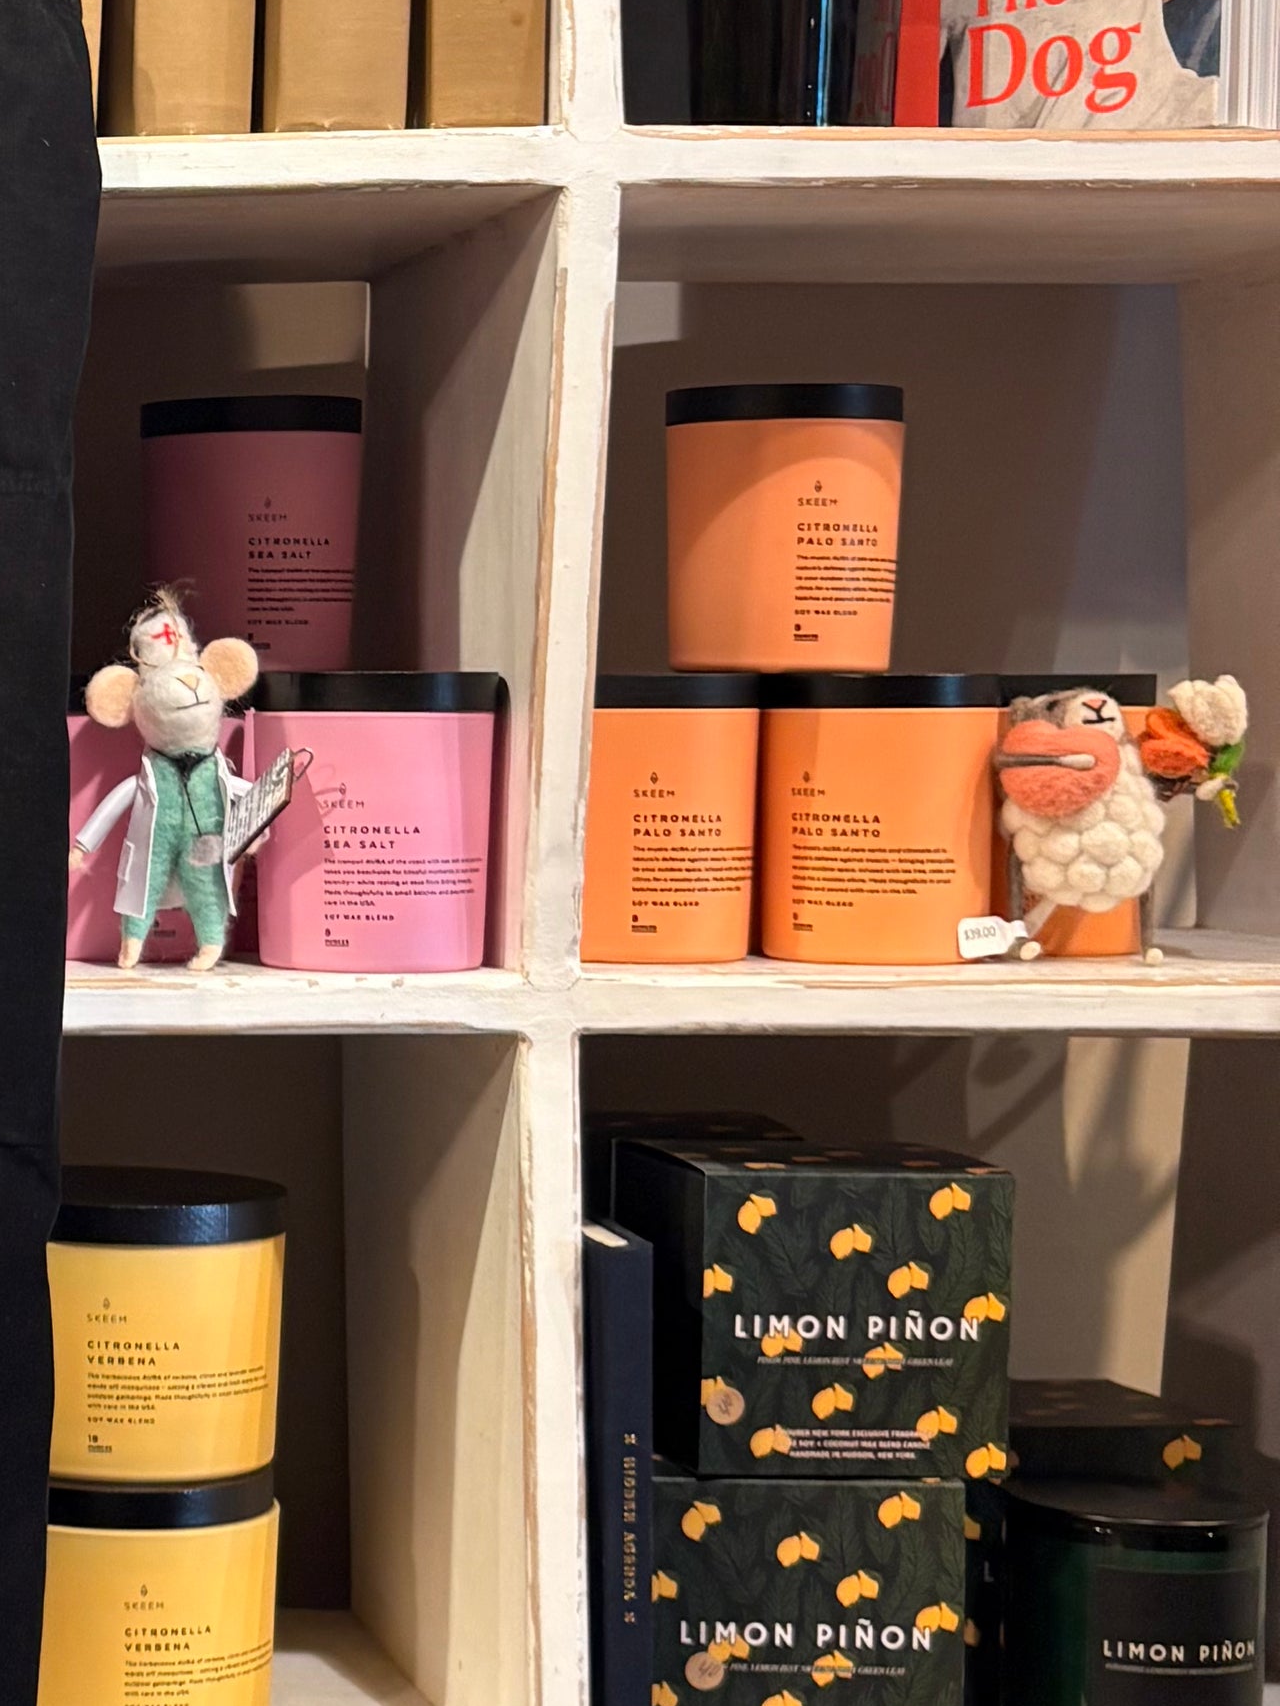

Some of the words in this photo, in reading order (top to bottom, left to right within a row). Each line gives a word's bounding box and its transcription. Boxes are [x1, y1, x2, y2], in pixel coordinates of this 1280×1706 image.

[964, 22, 1142, 115] Dog
[797, 497, 838, 507] SKEEM
[797, 522, 878, 533] CITRONELLA
[248, 537, 330, 545] CITRONELLA
[796, 536, 834, 547] PALO
[841, 536, 878, 547] SANTO
[248, 550, 274, 559] SEA
[281, 550, 312, 559] SALT
[633, 789, 675, 798] SKEEM
[323, 799, 365, 809] SKEEM
[633, 814, 722, 823] CITRONELLA
[791, 812, 880, 824] CITRONELLA
[323, 825, 421, 835] CITRONELLA
[633, 828, 672, 837] PALO
[679, 828, 722, 837] SANTO
[792, 826, 823, 836] PALO
[830, 827, 880, 838] SANTO
[323, 840, 351, 849] SEA
[359, 840, 395, 849] SALT
[87, 1313, 127, 1324] SKEEM
[734, 1314, 845, 1340] LIMON
[868, 1310, 981, 1341] PIÑON
[87, 1340, 180, 1351] CITRONELLA
[87, 1355, 156, 1366] VERBENA
[623, 1455, 637, 1524] HIDDEN
[623, 1531, 638, 1602] AGENDA
[124, 1601, 164, 1611] SKEEM
[124, 1625, 211, 1638] CITRONELLA
[680, 1620, 794, 1648] LIMON
[817, 1618, 932, 1651] PIÑON
[124, 1643, 190, 1652] VERBENA
[1103, 1639, 1185, 1662] LIMON
[1199, 1639, 1255, 1662] PIÑON
